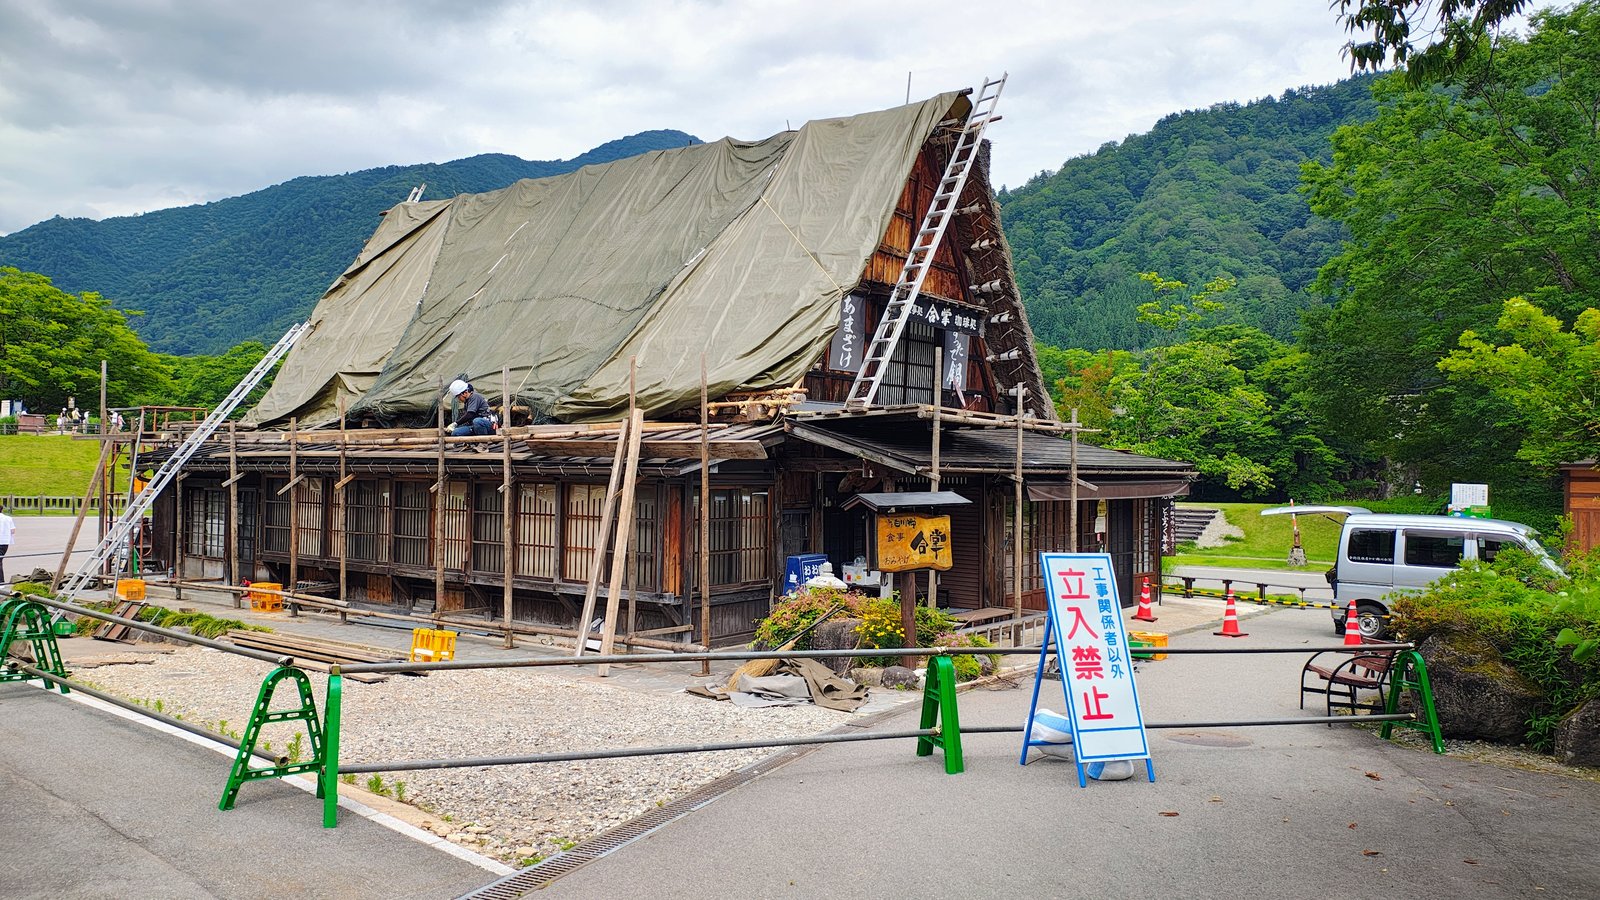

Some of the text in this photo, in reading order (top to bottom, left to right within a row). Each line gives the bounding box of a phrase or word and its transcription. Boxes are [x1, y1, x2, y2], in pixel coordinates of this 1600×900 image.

[839, 294, 857, 369] あまざけ
[925, 303, 952, 327] 合掌
[886, 532, 905, 543] 食事
[910, 528, 946, 560] 合掌
[1057, 567, 1114, 721] 立入禁止
[1092, 567, 1125, 680] 工事関係者以外
